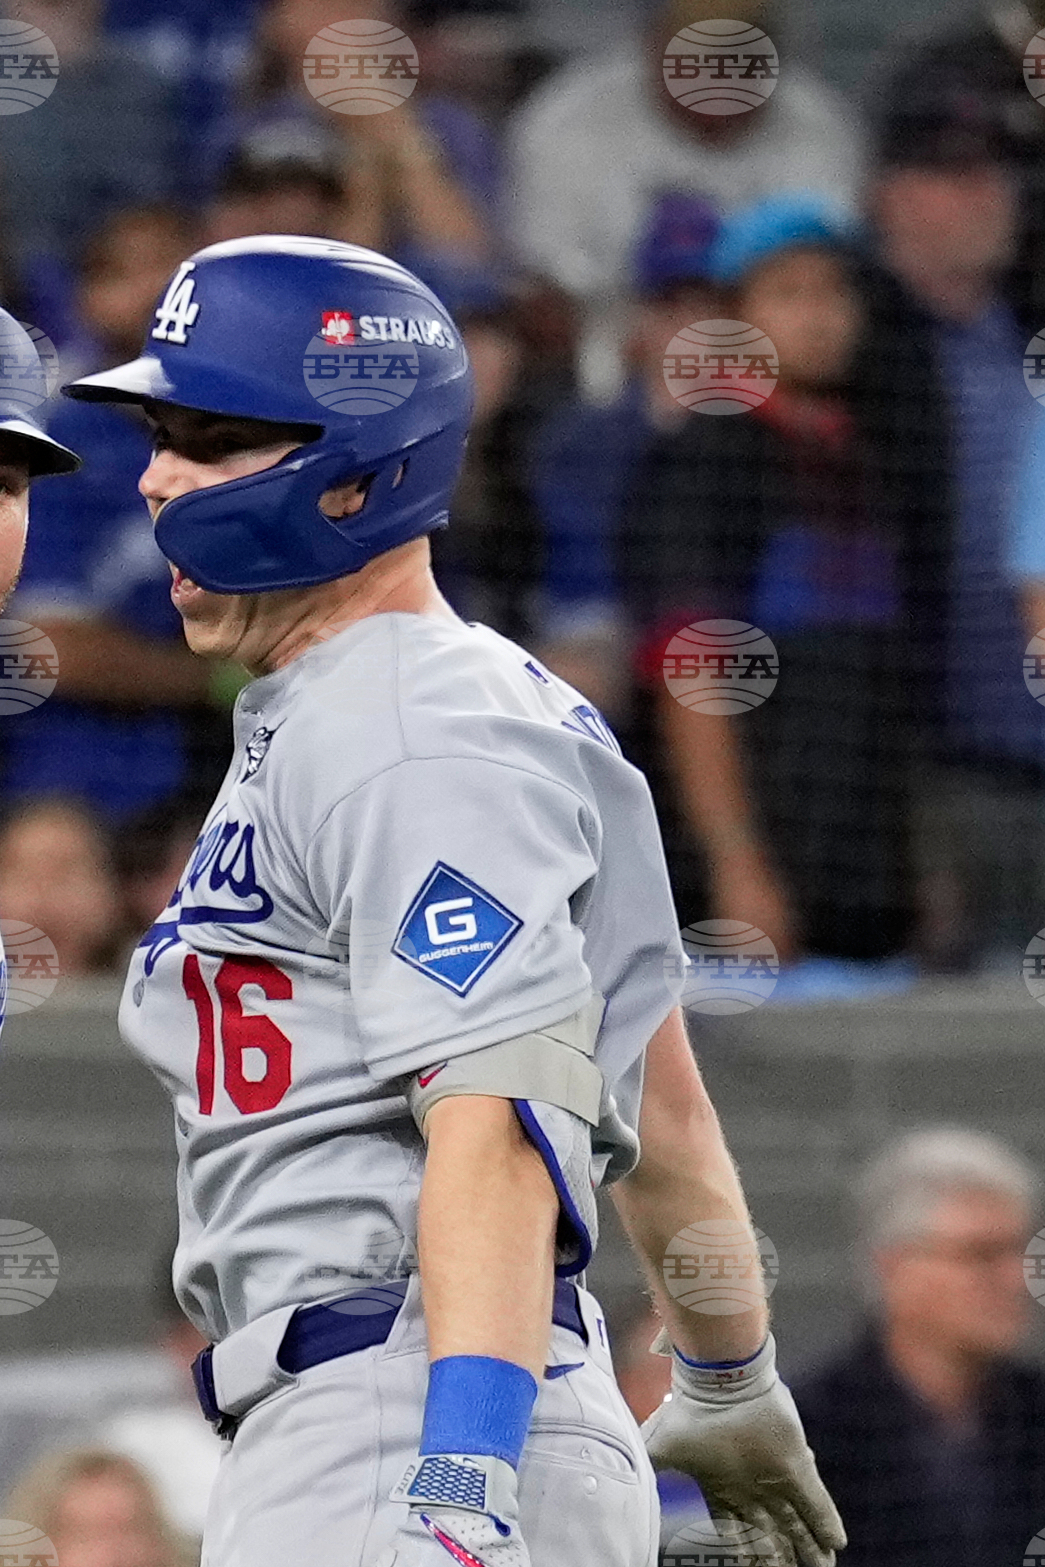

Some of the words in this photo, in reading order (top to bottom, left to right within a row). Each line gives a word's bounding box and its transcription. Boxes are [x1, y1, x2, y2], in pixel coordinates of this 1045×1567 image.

[151, 260, 200, 344] LA
[358, 314, 456, 350] STRAUSS
[182, 956, 294, 1116] 16
